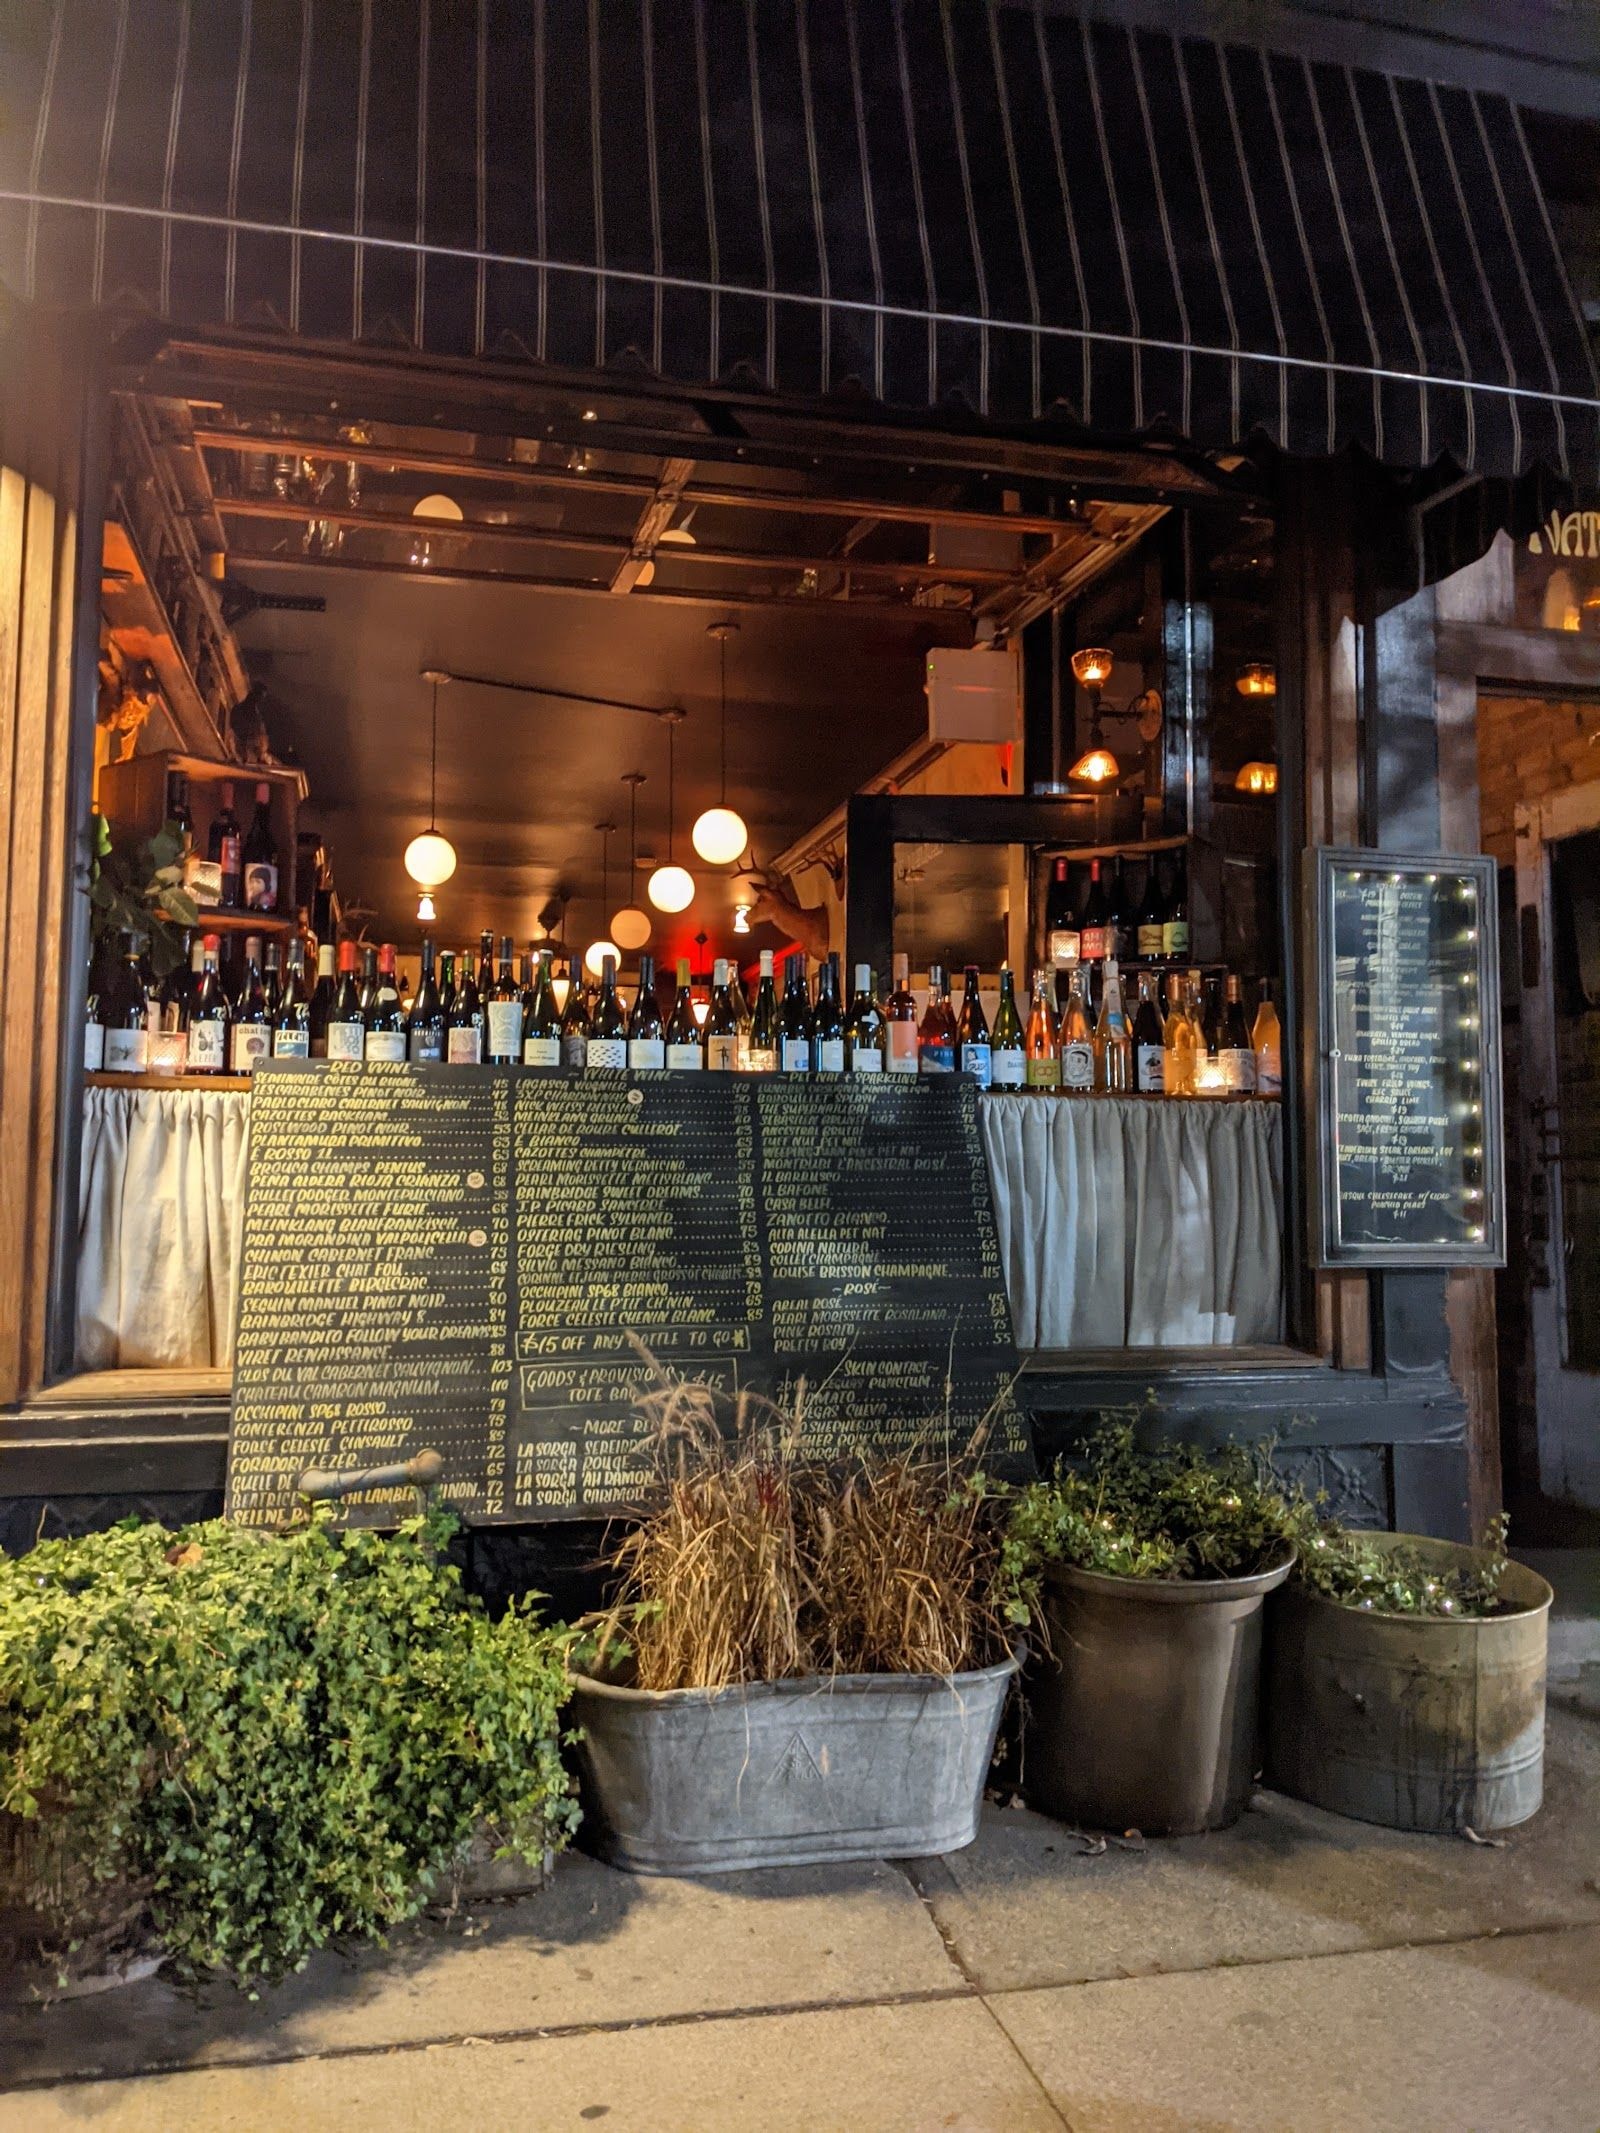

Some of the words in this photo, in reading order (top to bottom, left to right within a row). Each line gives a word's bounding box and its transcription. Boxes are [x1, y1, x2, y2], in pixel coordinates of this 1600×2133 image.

[330, 1061, 362, 1073] RED
[367, 1062, 411, 1074] WINE
[584, 1067, 630, 1080] WHITE
[634, 1070, 672, 1082] WINE
[855, 1072, 918, 1085] SPARKLING
[352, 1086, 393, 1098] PINOT
[393, 1088, 426, 1098] NOIR
[491, 1090, 508, 1100] 47
[252, 1096, 296, 1108] PABLO
[297, 1097, 336, 1108] CLARO
[400, 1098, 470, 1112] SAUVIGNON
[514, 1100, 544, 1111] NICK
[252, 1122, 328, 1134] ROSEWOOD
[330, 1122, 376, 1134] PINOT
[374, 1122, 410, 1134] NOIR
[514, 1122, 557, 1134] CELLAR
[528, 1135, 580, 1148] BIANCO
[264, 1148, 312, 1160] ROSSO
[514, 1147, 578, 1158] CAZOTTES
[310, 1161, 370, 1174] CHAMPS
[374, 1162, 426, 1174] PENTUS
[492, 1162, 508, 1174] 68
[349, 1174, 394, 1188] RIOJA
[396, 1174, 460, 1187] CRIANZA
[492, 1176, 507, 1187] 68
[515, 1173, 554, 1186] PEARL
[516, 1186, 599, 1200] BAINBRIDGE
[602, 1186, 643, 1198] SWEET
[646, 1186, 701, 1198] DREAMS
[246, 1203, 291, 1217] PEARL
[546, 1200, 597, 1213] PICARD
[764, 1198, 796, 1212] CASA
[245, 1218, 336, 1234] MEINKLANG
[492, 1217, 508, 1230] 70
[516, 1213, 566, 1228] PIERRE
[566, 1212, 607, 1226] FRICK
[245, 1233, 275, 1246] PRA
[376, 1231, 468, 1245] VALPOLICELLA
[491, 1232, 508, 1244] 70
[517, 1228, 583, 1242] OSTERTAG
[586, 1226, 628, 1240] PINOT
[630, 1226, 674, 1240] BLANC
[740, 1225, 758, 1238] 75
[798, 1228, 838, 1240] ALELLA
[840, 1228, 860, 1240] PET
[862, 1226, 886, 1240] NAT
[244, 1248, 304, 1262] CHINON
[308, 1248, 384, 1262] CABERNET
[386, 1246, 434, 1261] FRANC
[490, 1246, 508, 1260] 75
[517, 1243, 562, 1260] FORGE
[564, 1242, 592, 1258] DRY
[770, 1241, 814, 1255] CODINA
[982, 1240, 997, 1251] 65
[244, 1264, 278, 1280] ERIC
[280, 1264, 331, 1280] TEXIER
[336, 1263, 372, 1278] CHAT
[374, 1262, 402, 1276] FOU
[491, 1260, 508, 1274] 68
[630, 1255, 677, 1270] BIANCO
[773, 1266, 816, 1278] LOUISE
[820, 1265, 872, 1278] BRISSON
[874, 1263, 948, 1279] CHAMPAGNE
[983, 1266, 1001, 1279] 115
[587, 1283, 620, 1298] SP68
[623, 1282, 669, 1297] BIANCO
[746, 1281, 762, 1294] 79
[844, 1278, 880, 1295] ROSÉ
[242, 1297, 296, 1314] SEGUIN
[298, 1296, 359, 1312] MANUEL
[362, 1294, 406, 1310] PINOT
[408, 1293, 446, 1308] NOIR
[489, 1292, 507, 1304] 80
[592, 1299, 606, 1312] LE
[812, 1294, 842, 1310] ROSÉ
[240, 1312, 336, 1328] BAINBRIDGE
[340, 1310, 412, 1326] HIGHWAY
[489, 1308, 506, 1322] 84
[519, 1313, 562, 1330] FORCE
[565, 1311, 617, 1327] CELESTE
[618, 1310, 670, 1326] CHENIN
[671, 1308, 716, 1324] BLANC
[746, 1308, 764, 1322] 85
[772, 1312, 808, 1325] PEARL
[236, 1331, 280, 1348] BABY
[279, 1328, 342, 1346] BANDITO
[346, 1327, 401, 1344] FOLLOW
[402, 1326, 439, 1342] YOUR
[773, 1326, 806, 1339] PINK
[992, 1332, 1012, 1344] 55
[520, 1332, 560, 1354] $15
[562, 1335, 586, 1352] OFF
[593, 1334, 624, 1350] ANY
[689, 1331, 708, 1346] TO
[284, 1344, 392, 1364] RENAISSANCE
[490, 1343, 506, 1356] 88
[237, 1368, 270, 1382] CLOS
[272, 1367, 293, 1382] DU
[297, 1366, 320, 1382] VAL
[320, 1362, 393, 1380] CABERNET
[394, 1360, 474, 1378] SAUVIGNON
[491, 1359, 512, 1374] 103
[844, 1359, 878, 1377] SKIN
[878, 1360, 928, 1376] CONTACT
[526, 1370, 576, 1393] GOODS
[236, 1385, 302, 1402] CHATEAU
[368, 1380, 440, 1398] MAGNUM
[569, 1386, 603, 1402] TOTE
[346, 1402, 386, 1418] ROSSO
[490, 1398, 506, 1412] 79
[488, 1414, 506, 1427] 75
[584, 1419, 626, 1435] MORE
[280, 1437, 333, 1454] CELESTE
[340, 1434, 408, 1452] CINSAULT
[486, 1444, 505, 1458] 72
[517, 1442, 534, 1458] LA
[1009, 1440, 1028, 1452] 110
[486, 1462, 504, 1476] 65
[516, 1458, 532, 1474] LA
[487, 1480, 504, 1498] 72
[516, 1474, 532, 1490] LA
[516, 1490, 532, 1506] LA
[486, 1499, 503, 1514] 72
